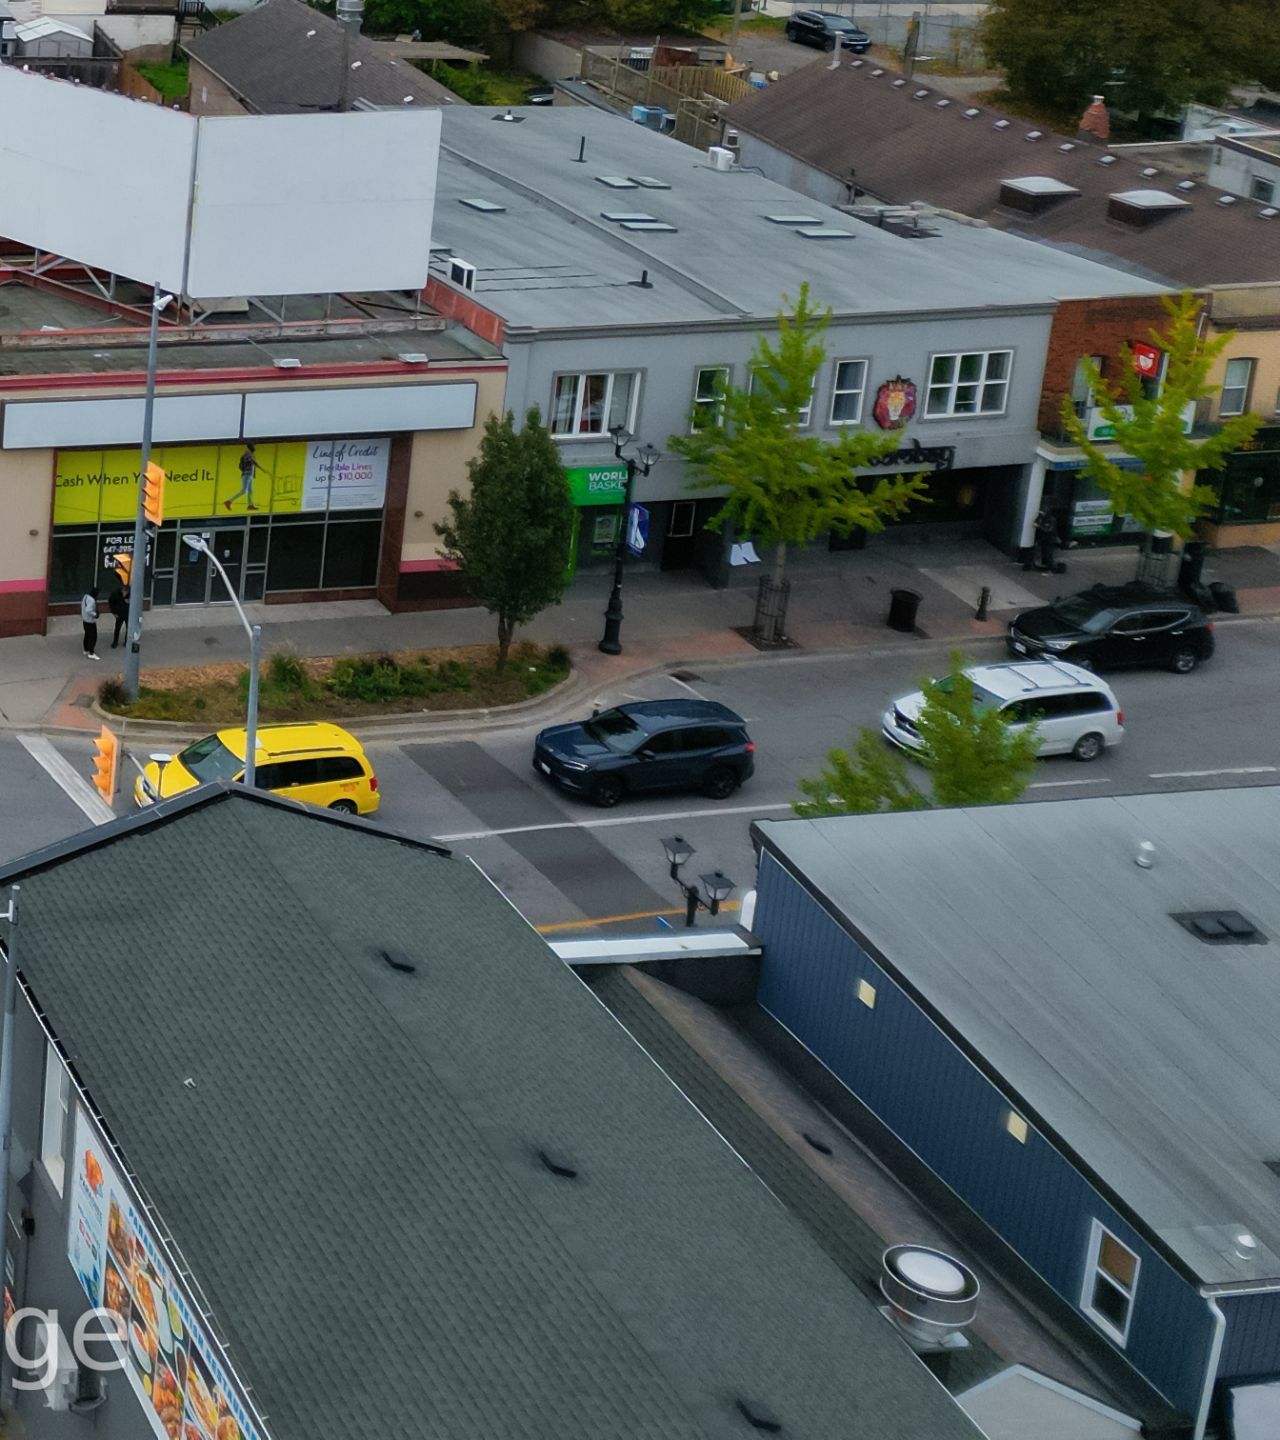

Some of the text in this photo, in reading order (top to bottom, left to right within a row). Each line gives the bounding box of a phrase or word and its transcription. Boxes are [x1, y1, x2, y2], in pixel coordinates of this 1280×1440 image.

[334, 443, 347, 462] of
[347, 444, 380, 457] Credit
[55, 473, 84, 488] Cash
[87, 472, 130, 486] When
[315, 475, 327, 483] up
[588, 470, 628, 481] WORL
[589, 480, 625, 491] BASKE
[106, 536, 122, 544] FOR
